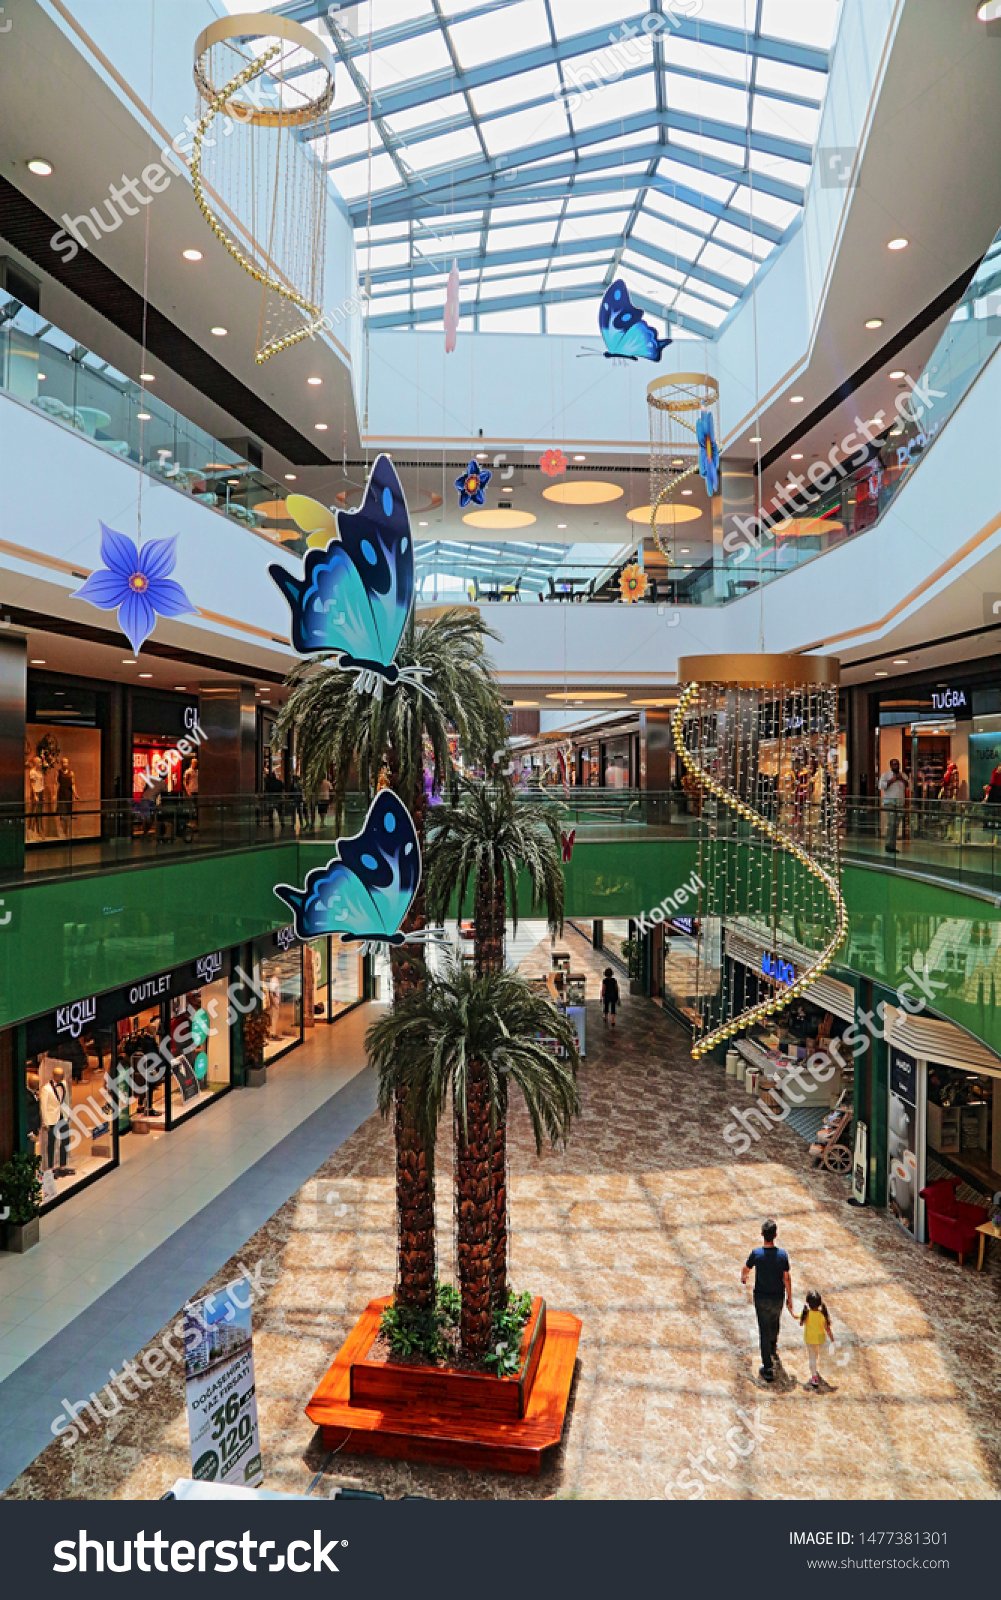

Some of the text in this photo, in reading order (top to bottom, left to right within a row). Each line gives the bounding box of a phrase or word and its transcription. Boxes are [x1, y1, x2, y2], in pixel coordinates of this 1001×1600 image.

[931, 688, 967, 709] TUĞBA
[129, 974, 172, 1004] OUTLET
[211, 1391, 239, 1440] 36
[219, 1414, 251, 1462] 120
